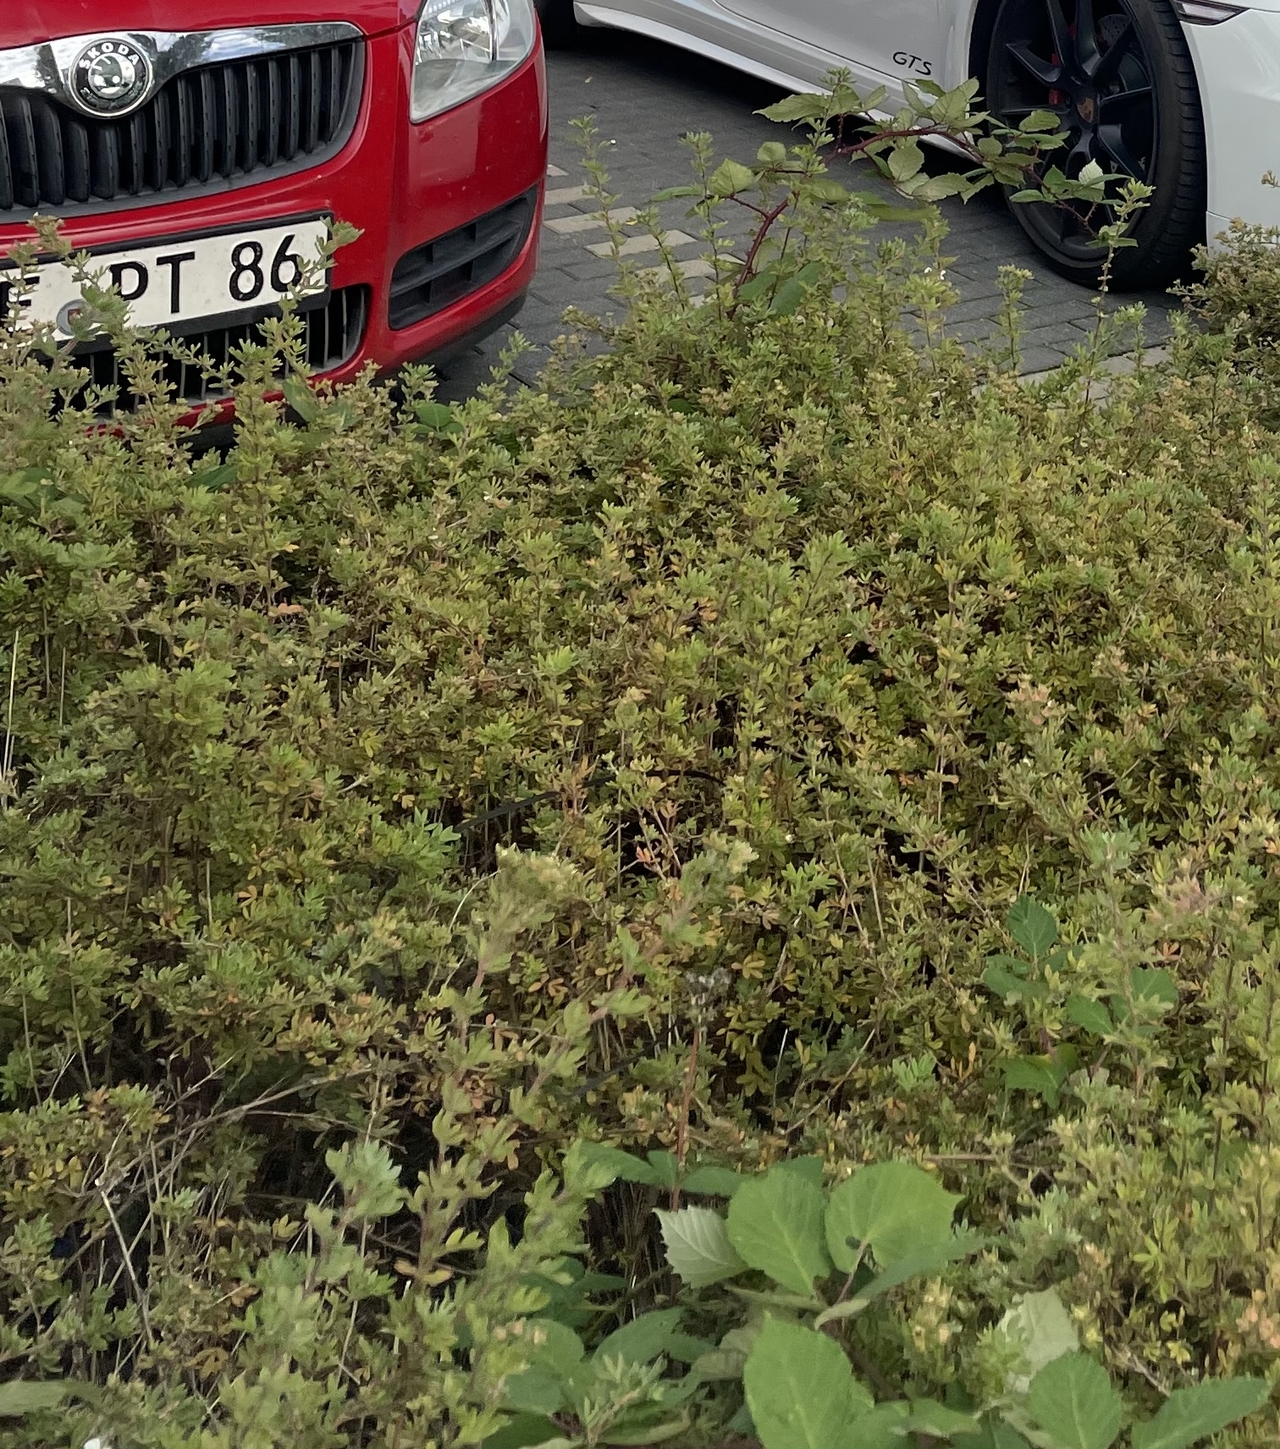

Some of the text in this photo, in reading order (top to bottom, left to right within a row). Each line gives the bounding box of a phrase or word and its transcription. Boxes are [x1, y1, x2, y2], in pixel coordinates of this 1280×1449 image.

[79, 42, 140, 70] SKODA
[892, 51, 932, 76] GTS
[109, 251, 196, 314] PT
[229, 233, 302, 302] 86
